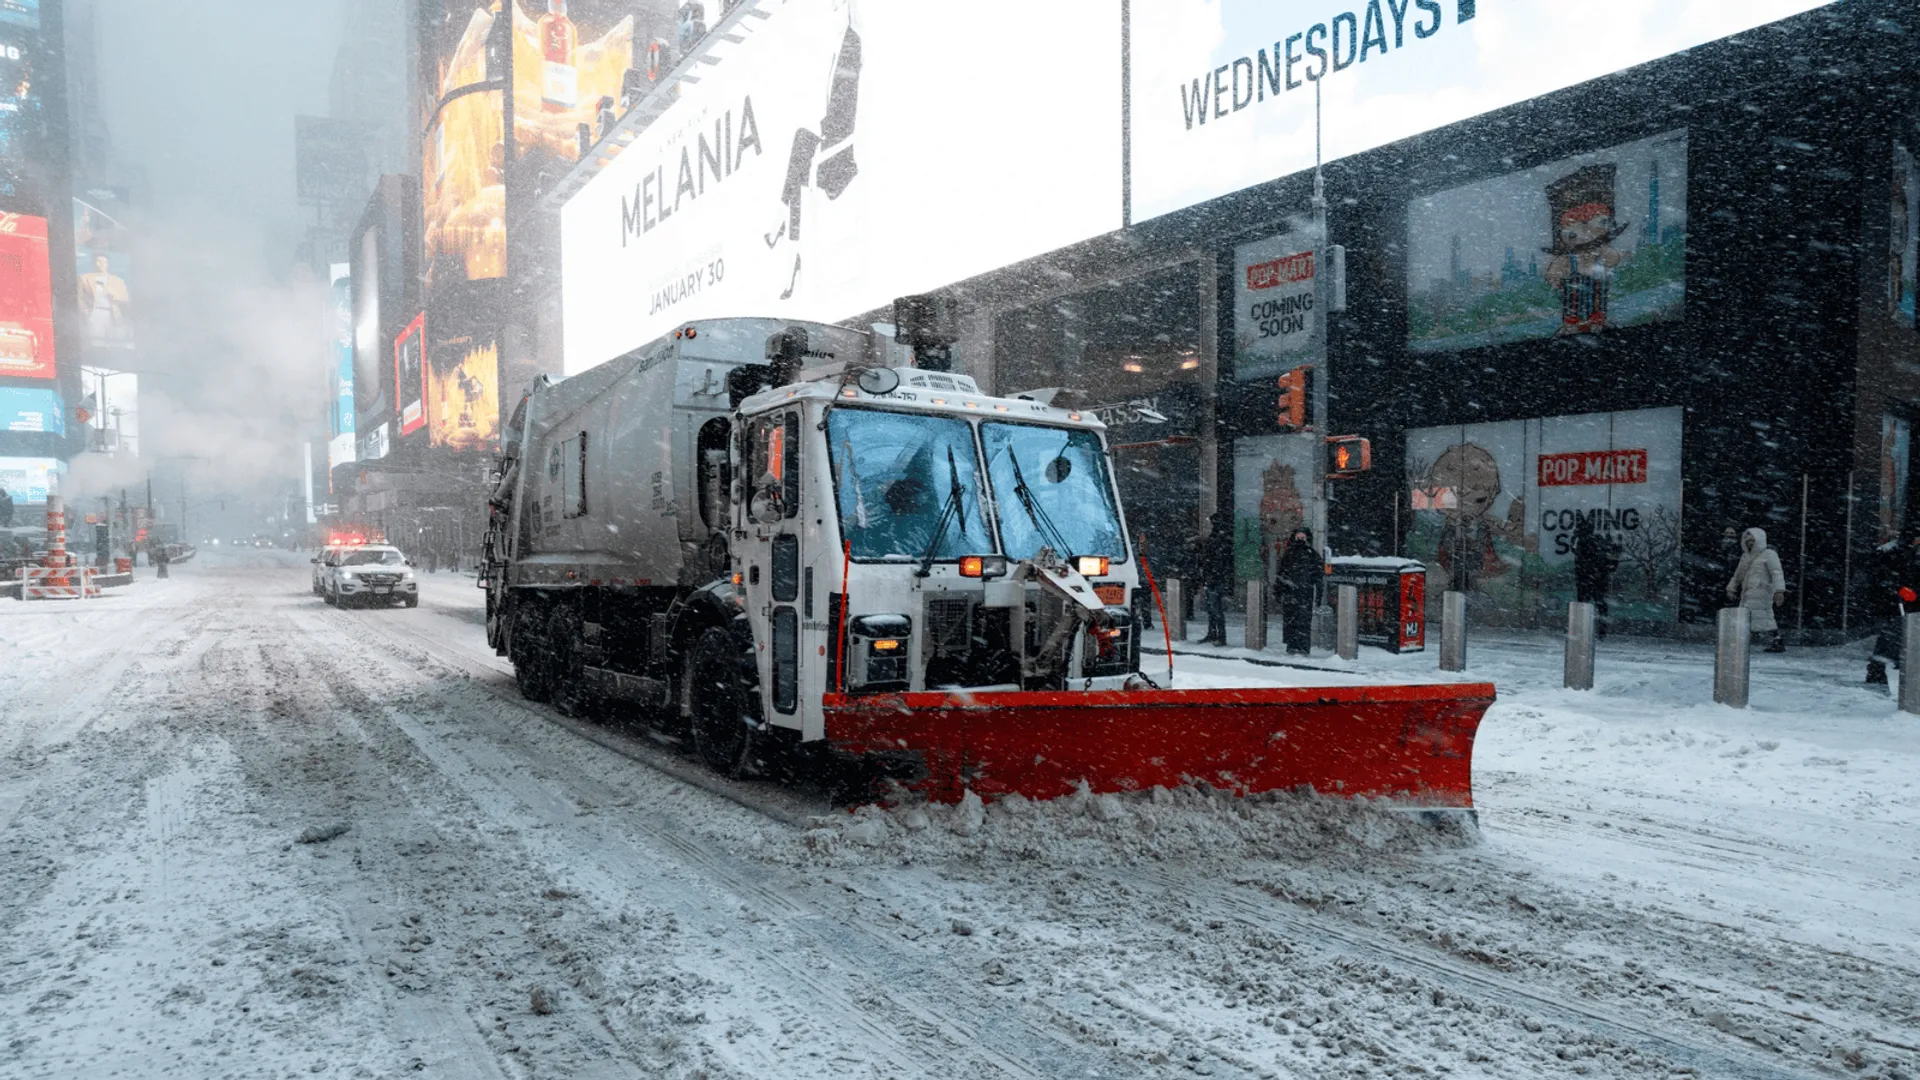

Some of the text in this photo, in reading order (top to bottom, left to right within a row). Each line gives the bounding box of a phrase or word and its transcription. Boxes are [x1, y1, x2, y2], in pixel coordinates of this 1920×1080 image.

[1180, 0, 1442, 131] WEDNESDAYS
[621, 94, 763, 249] MELANIA
[1250, 256, 1314, 286] POP MART
[648, 268, 704, 317] JANUARY
[708, 257, 725, 287] 30
[1251, 292, 1314, 321] COMING
[1259, 313, 1304, 338] SOON
[1542, 454, 1641, 482] POP MART
[1542, 507, 1640, 532] COMING
[1406, 621, 1418, 637] MJ
